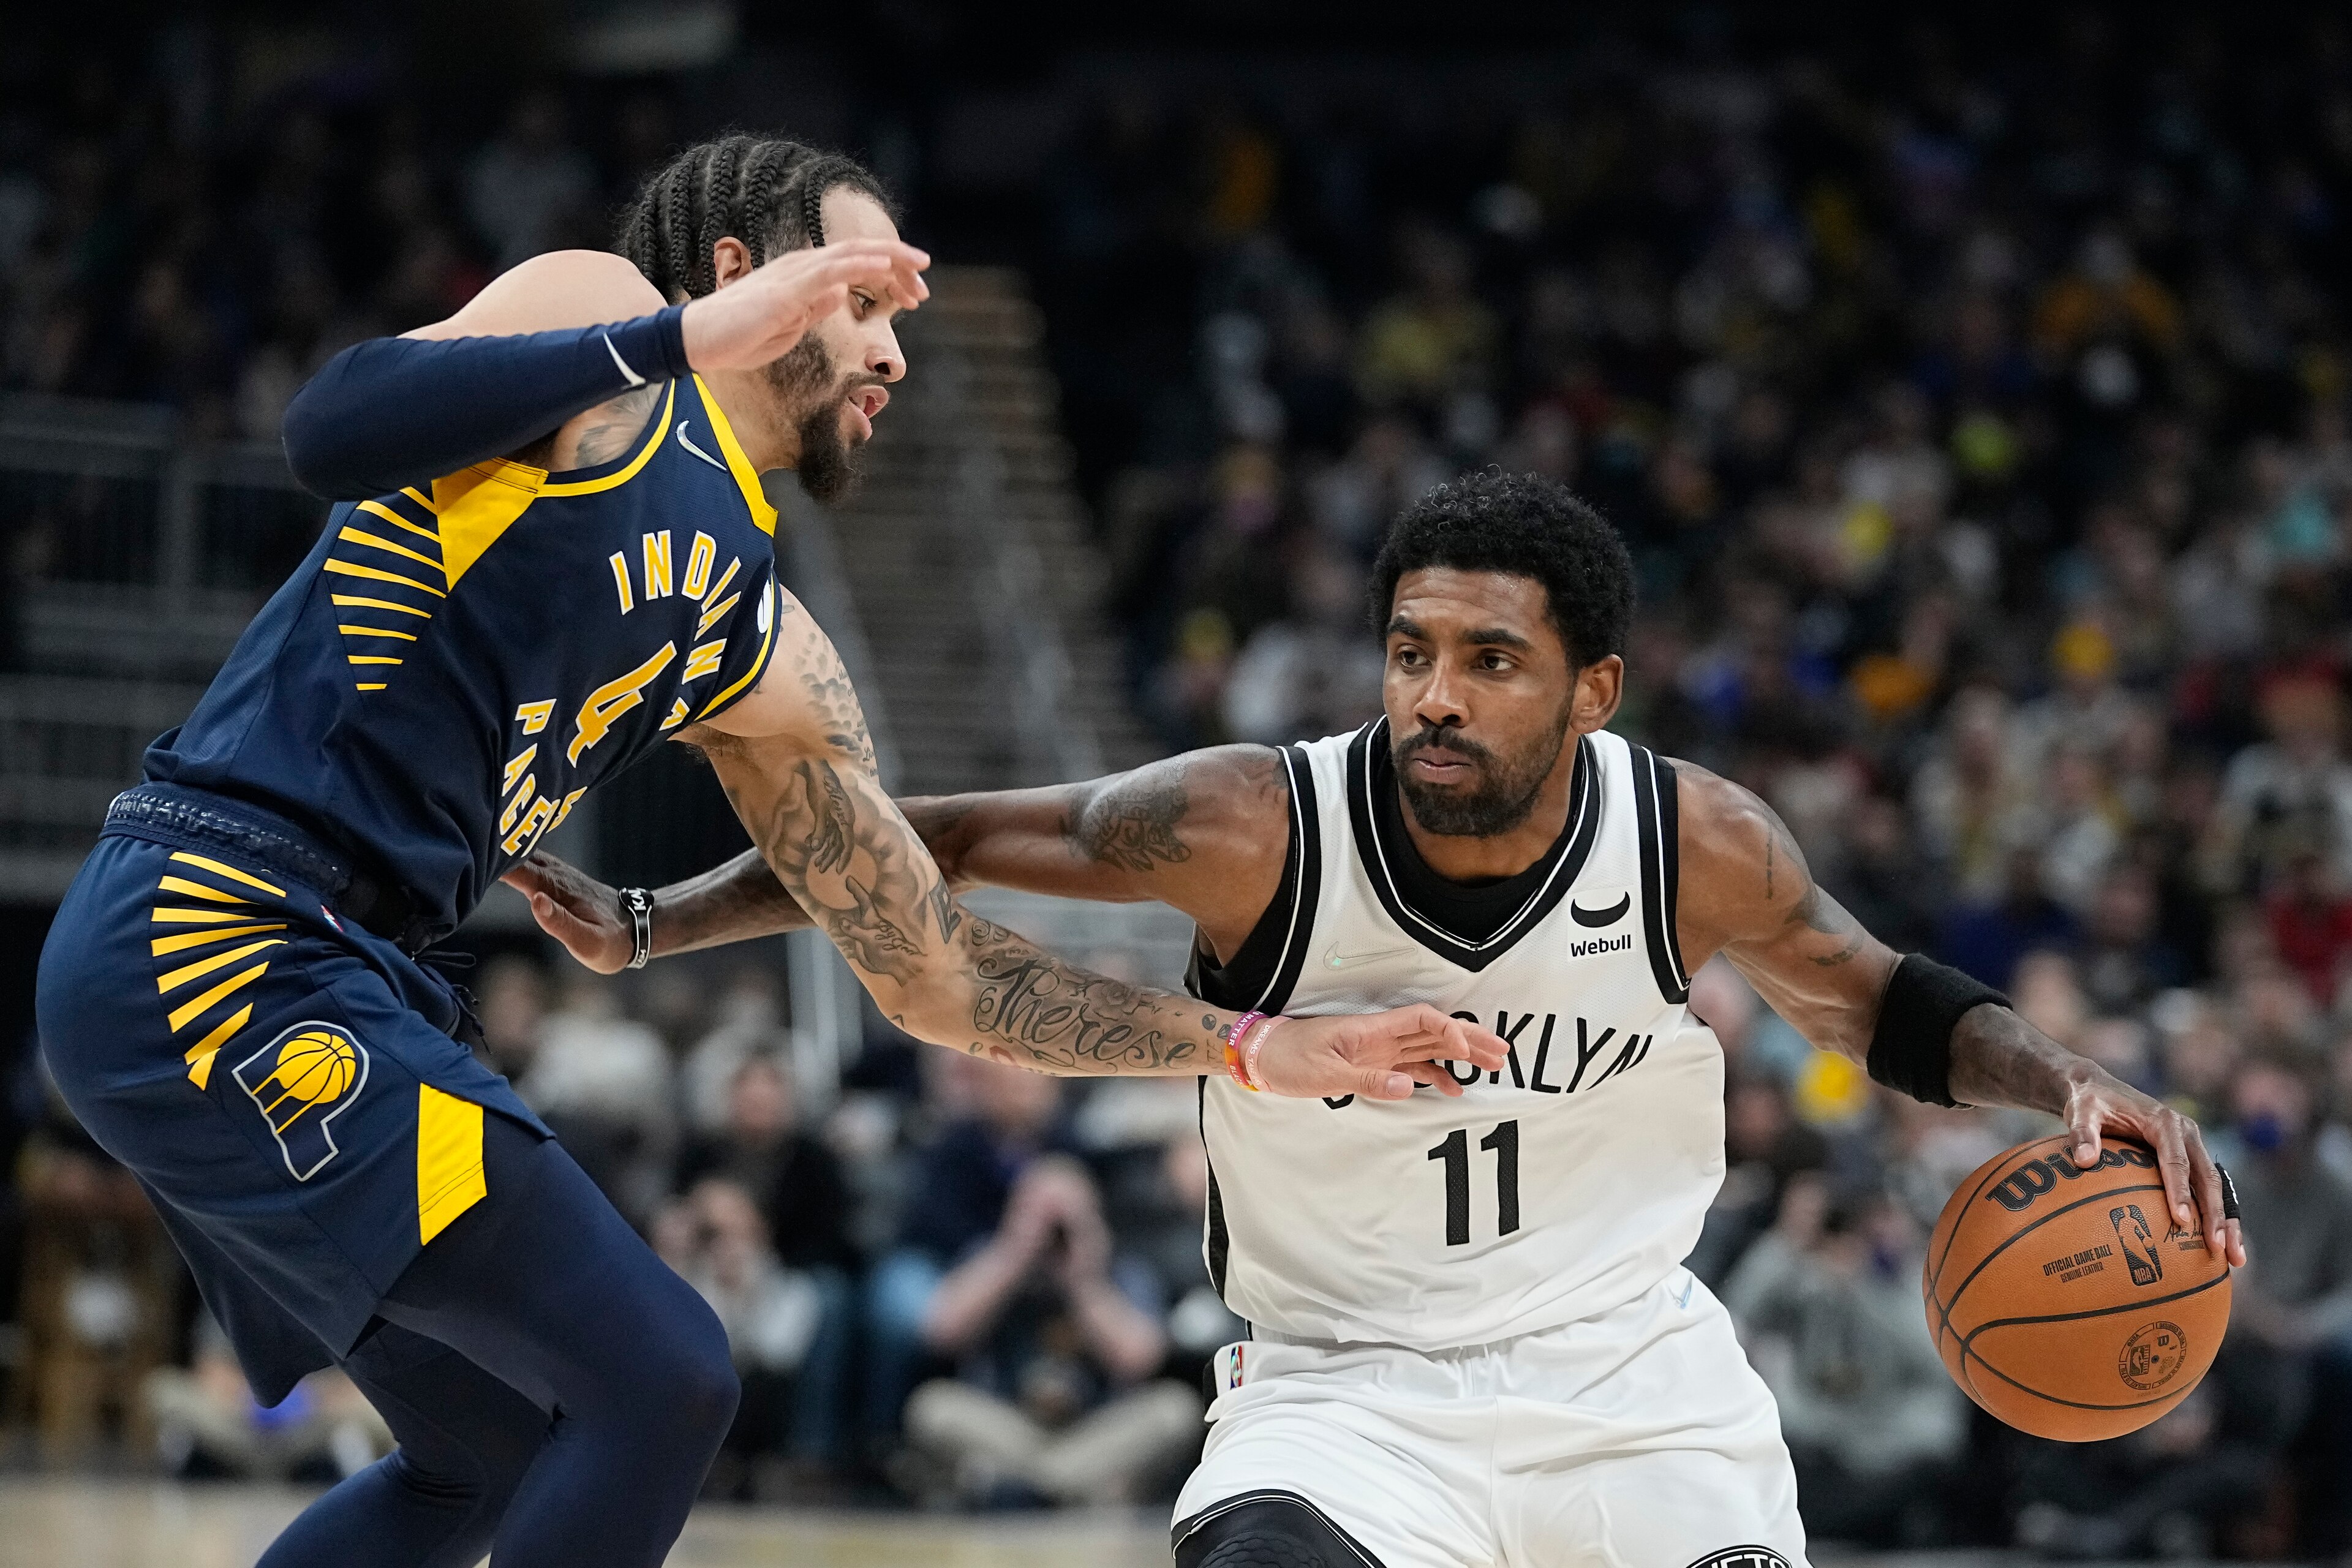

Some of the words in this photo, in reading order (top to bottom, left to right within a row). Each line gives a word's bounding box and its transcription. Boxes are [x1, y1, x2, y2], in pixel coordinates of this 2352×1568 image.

[609, 530, 741, 731] INDIANA
[567, 640, 677, 767] 4
[500, 699, 587, 858] PACES
[1570, 934, 1630, 957] Webull
[974, 959, 1196, 1073] Therese
[1228, 1015, 1254, 1046] MATTER
[1250, 1024, 1272, 1055] DREAMS
[1322, 1011, 1653, 1110] OKLYN
[1428, 1119, 1520, 1246] 11
[2043, 1256, 2075, 1276] OFFICIAL
[2074, 1248, 2096, 1265] GAME
[2095, 1244, 2113, 1261] BALL
[2060, 1267, 2083, 1283] GENUINE
[2082, 1261, 2104, 1276] LEATHER
[2134, 1267, 2152, 1283] NBA
